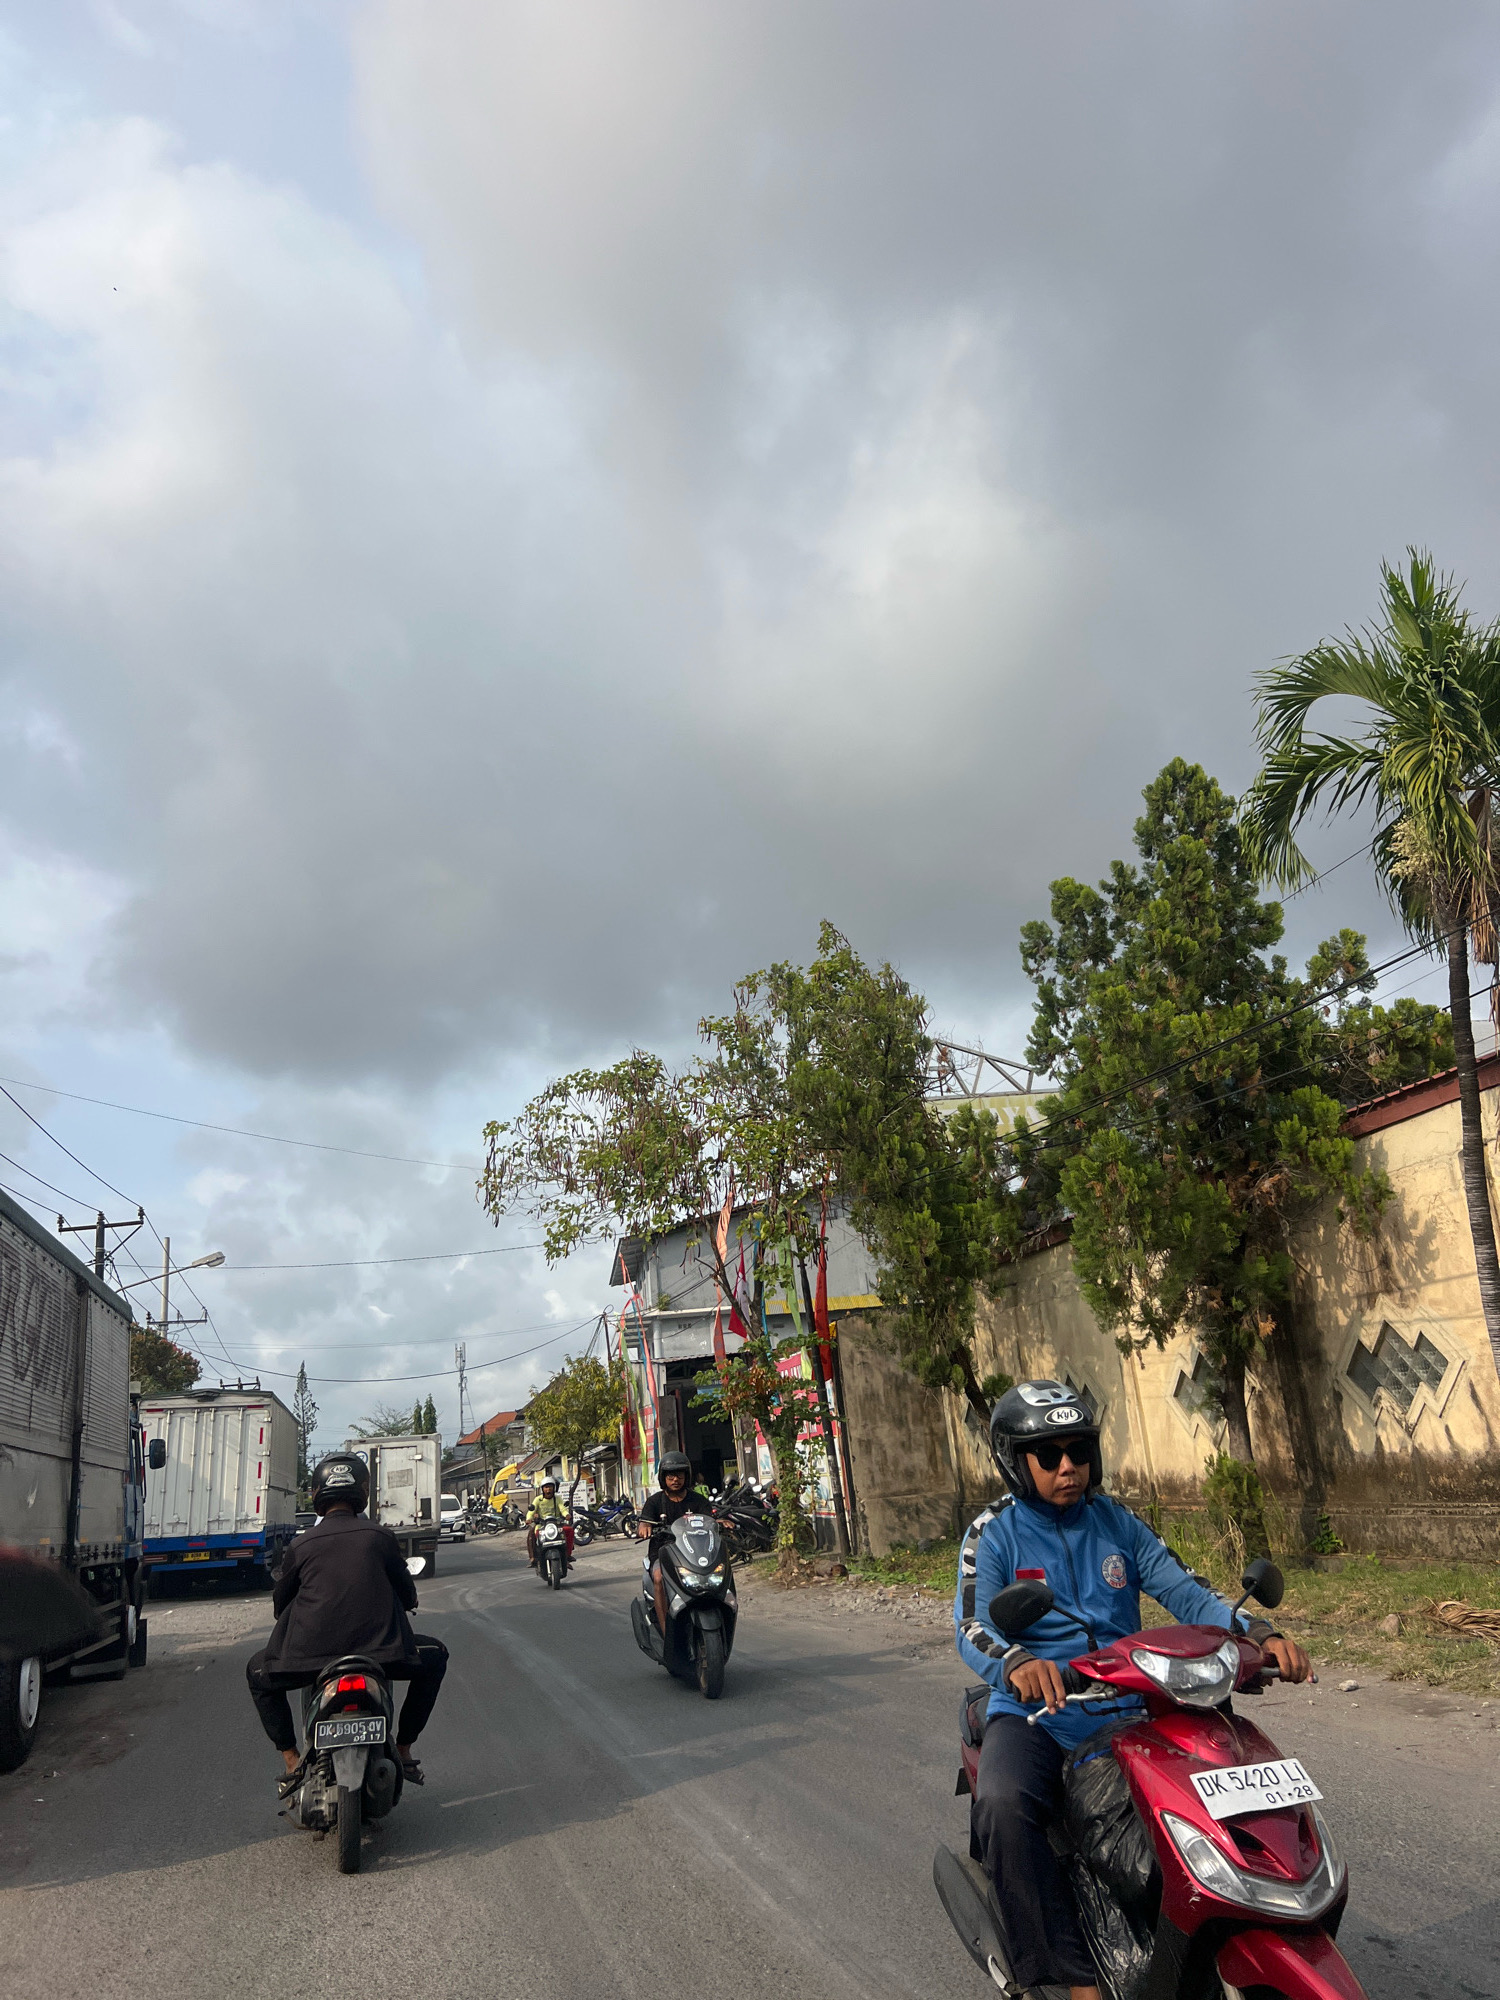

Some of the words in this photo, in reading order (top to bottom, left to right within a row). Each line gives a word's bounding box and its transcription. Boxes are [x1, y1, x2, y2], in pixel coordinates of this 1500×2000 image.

[320, 1724, 333, 1737] DK
[1197, 1774, 1229, 1797] DK
[1227, 1766, 1280, 1790] 5420
